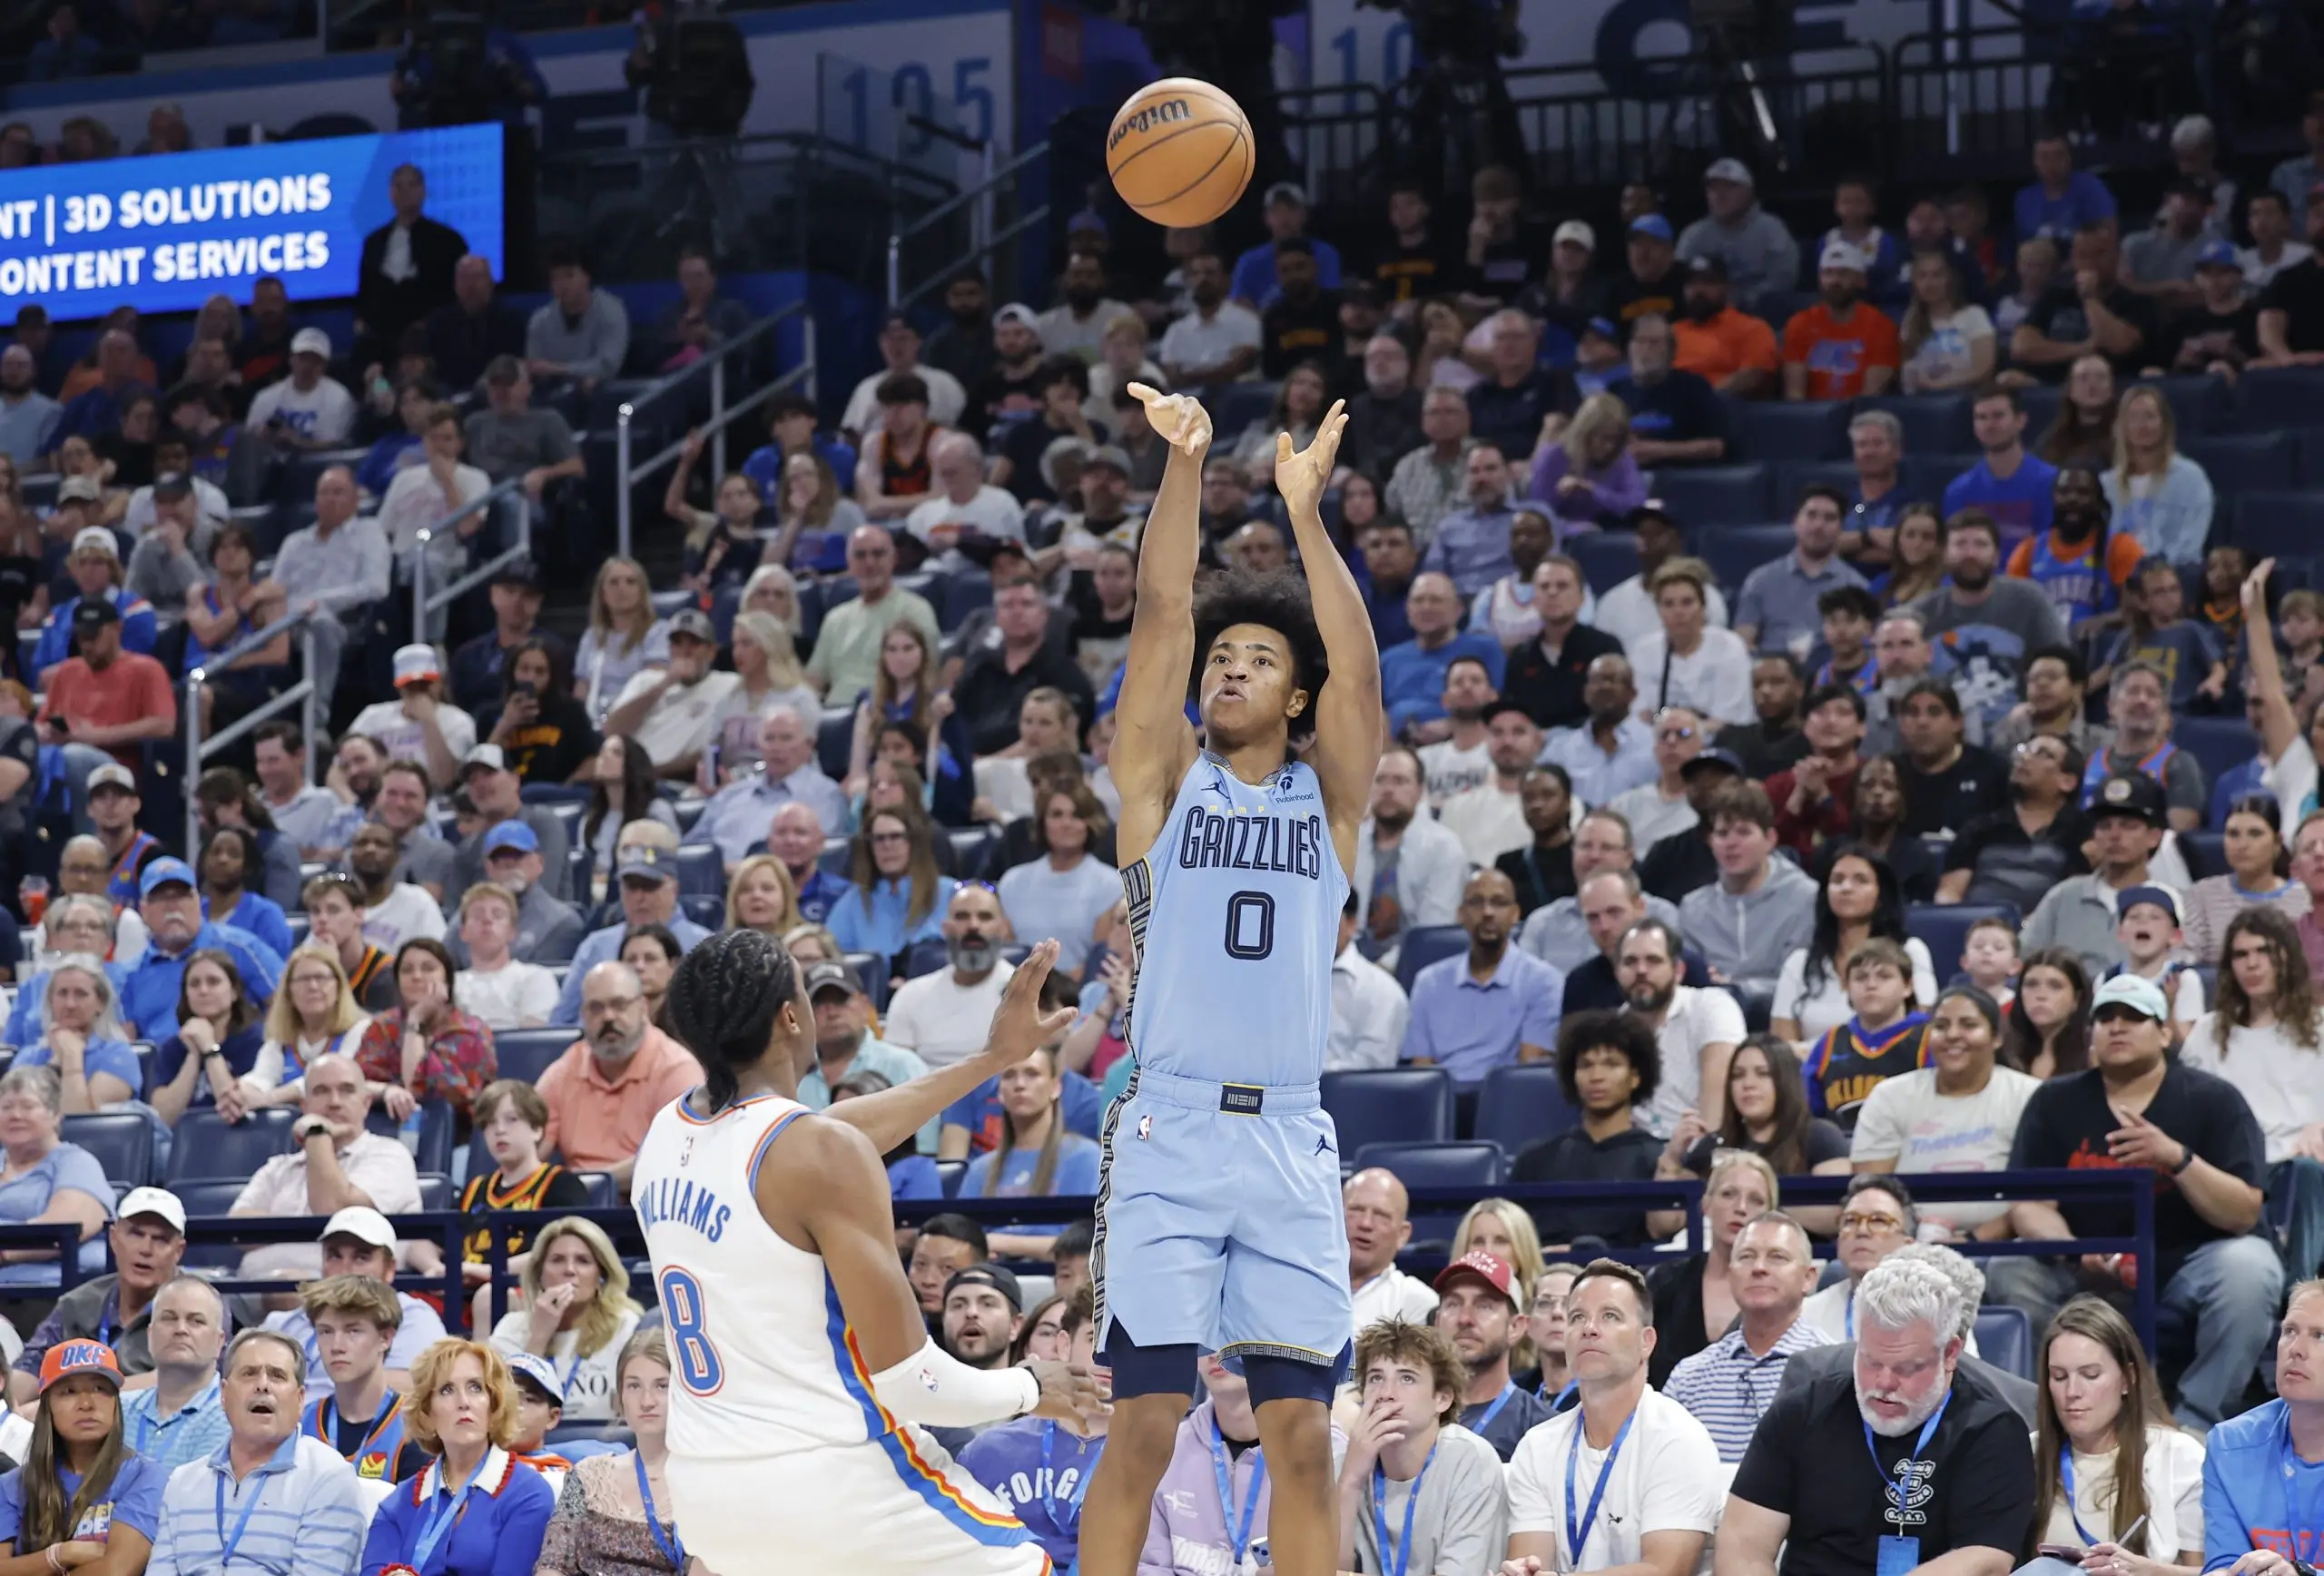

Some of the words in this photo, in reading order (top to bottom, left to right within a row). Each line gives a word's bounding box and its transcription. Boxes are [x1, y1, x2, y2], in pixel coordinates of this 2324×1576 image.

[842, 56, 995, 165] 105
[1109, 99, 1190, 153] Wilson
[64, 193, 112, 233] 3D
[118, 172, 332, 229] SOLUTIONS
[0, 246, 146, 296] ONTENT
[153, 230, 330, 283] SERVICES
[1275, 793, 1315, 804] Robinhood
[1179, 805, 1320, 881] GRIZZLIES
[1225, 890, 1275, 960] 0
[60, 1343, 106, 1370] OKC
[659, 1264, 725, 1397] 8
